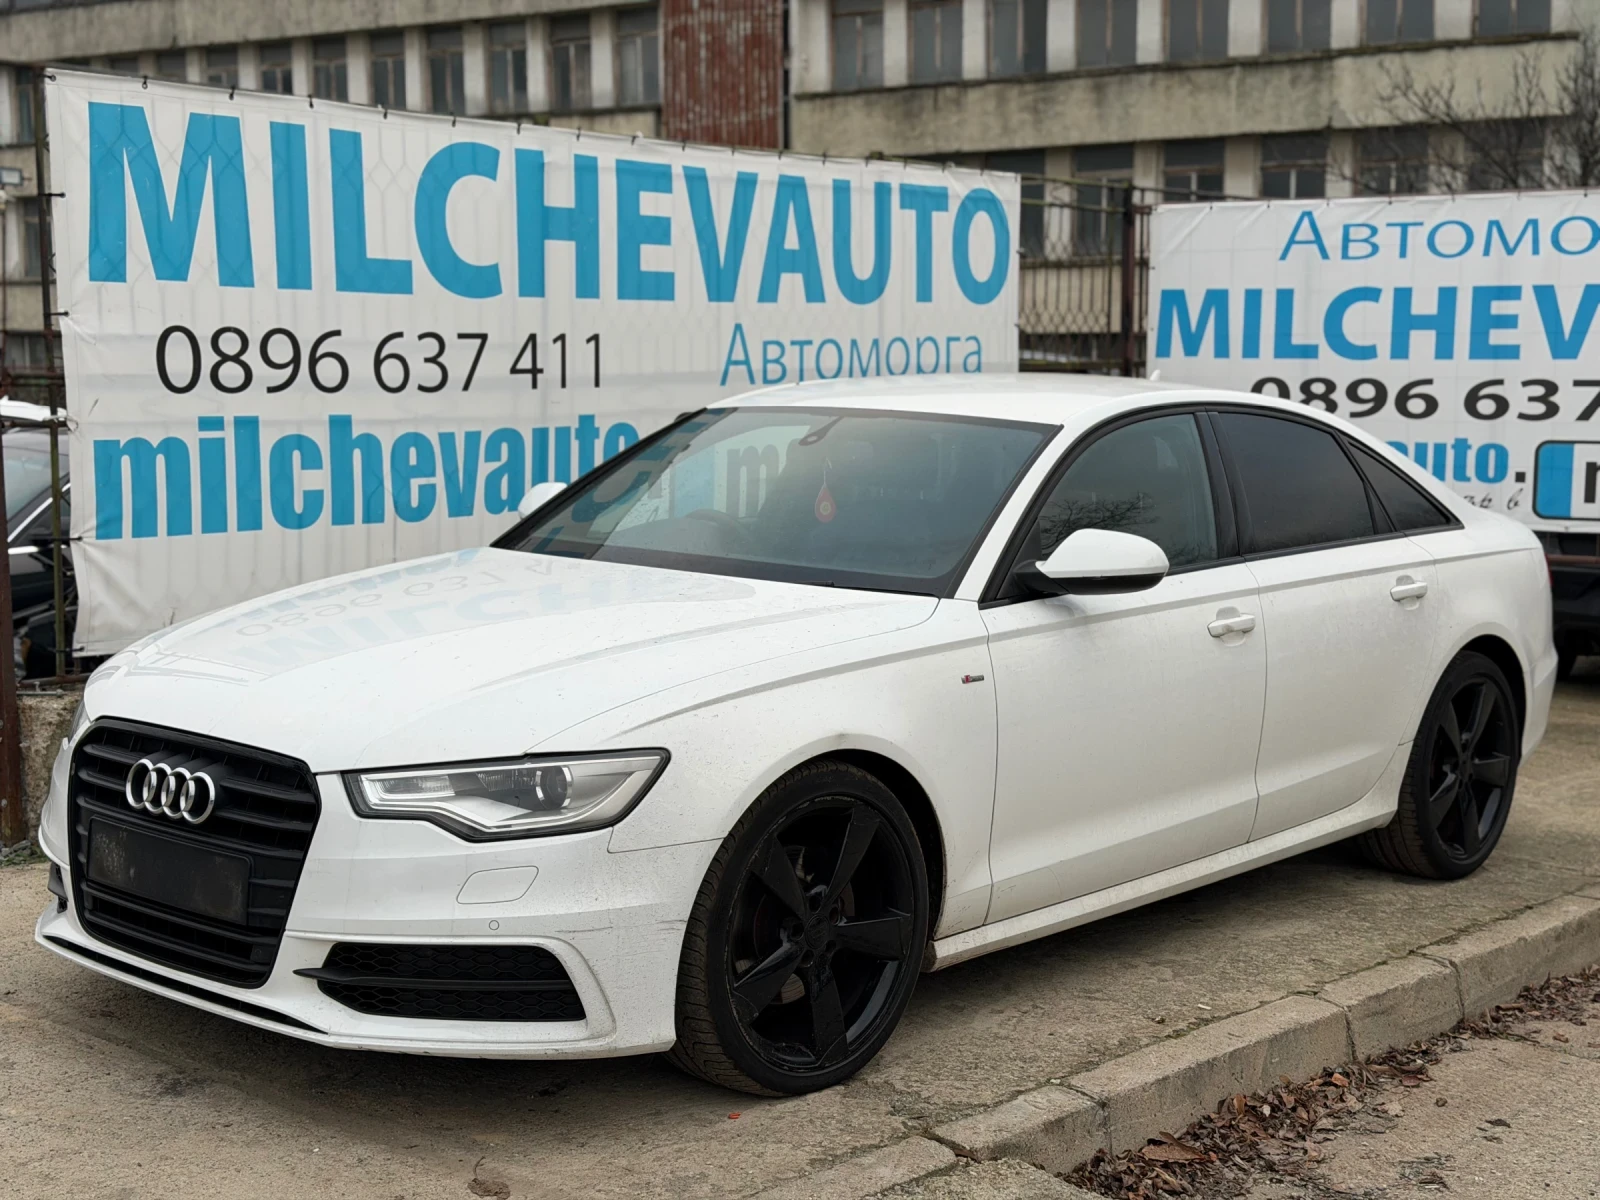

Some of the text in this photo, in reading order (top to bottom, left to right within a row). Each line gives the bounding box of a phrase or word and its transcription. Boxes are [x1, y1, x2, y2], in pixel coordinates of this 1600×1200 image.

[88, 102, 1010, 305] MILCHEVAUTO
[1280, 210, 1600, 261] Автомо
[721, 324, 981, 386] Автоморга
[1156, 284, 1600, 361] MILCHEV
[156, 326, 599, 394] 0896 637 411
[1464, 379, 1600, 421] 637
